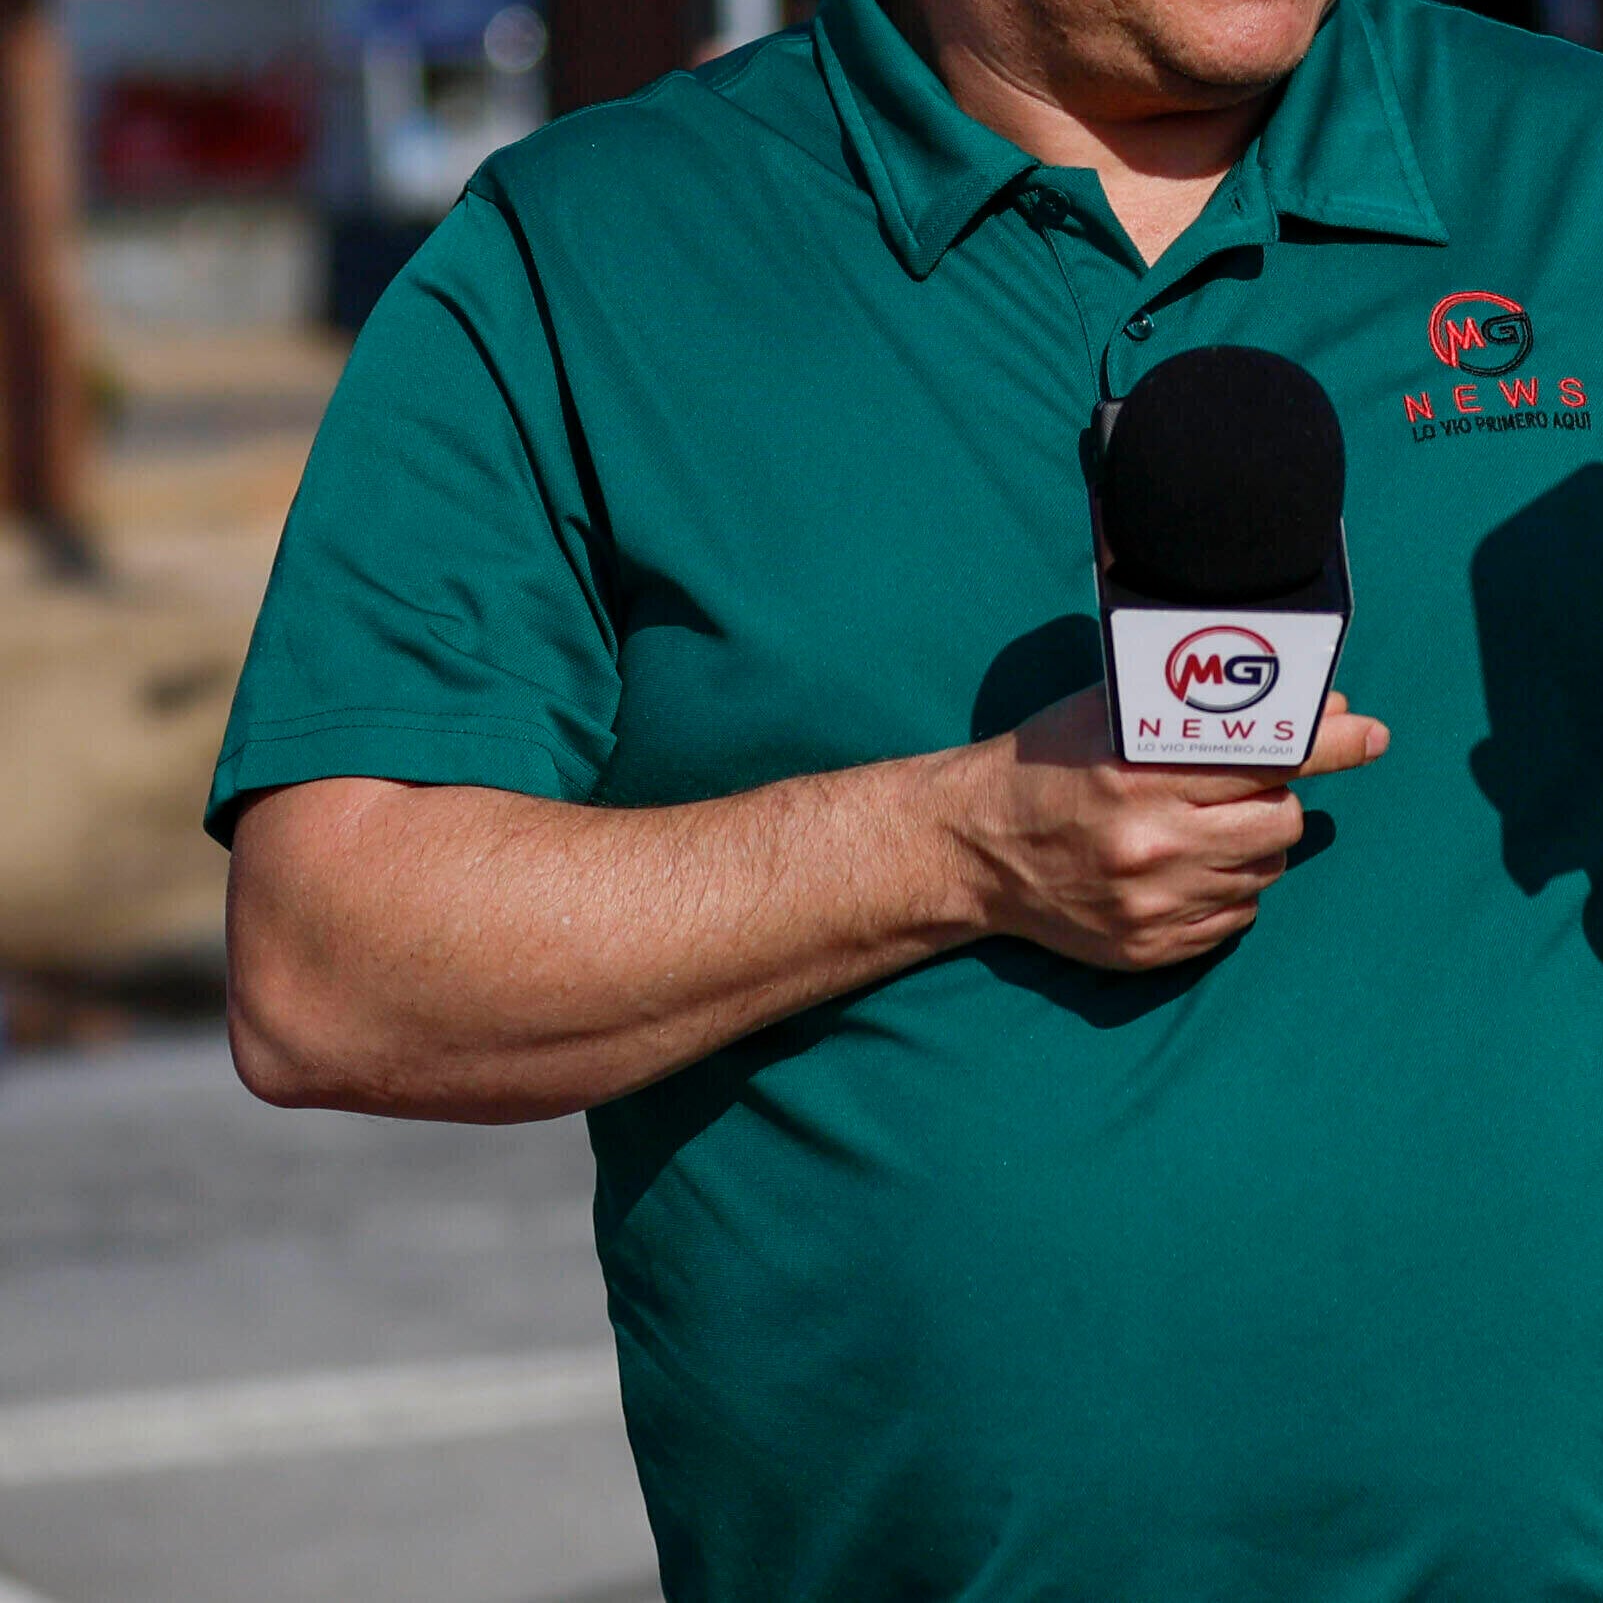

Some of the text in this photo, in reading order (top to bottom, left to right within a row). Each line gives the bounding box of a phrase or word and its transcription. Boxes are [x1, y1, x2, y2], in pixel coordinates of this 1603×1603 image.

[1403, 377, 1588, 423] NEWS
[1412, 424, 1436, 443] LO
[1475, 411, 1548, 432] PRIMERO
[1553, 411, 1592, 430] AQUI
[1138, 718, 1294, 741] NEWS
[1137, 743, 1156, 753] LO
[1189, 744, 1254, 754] PRIMERO
